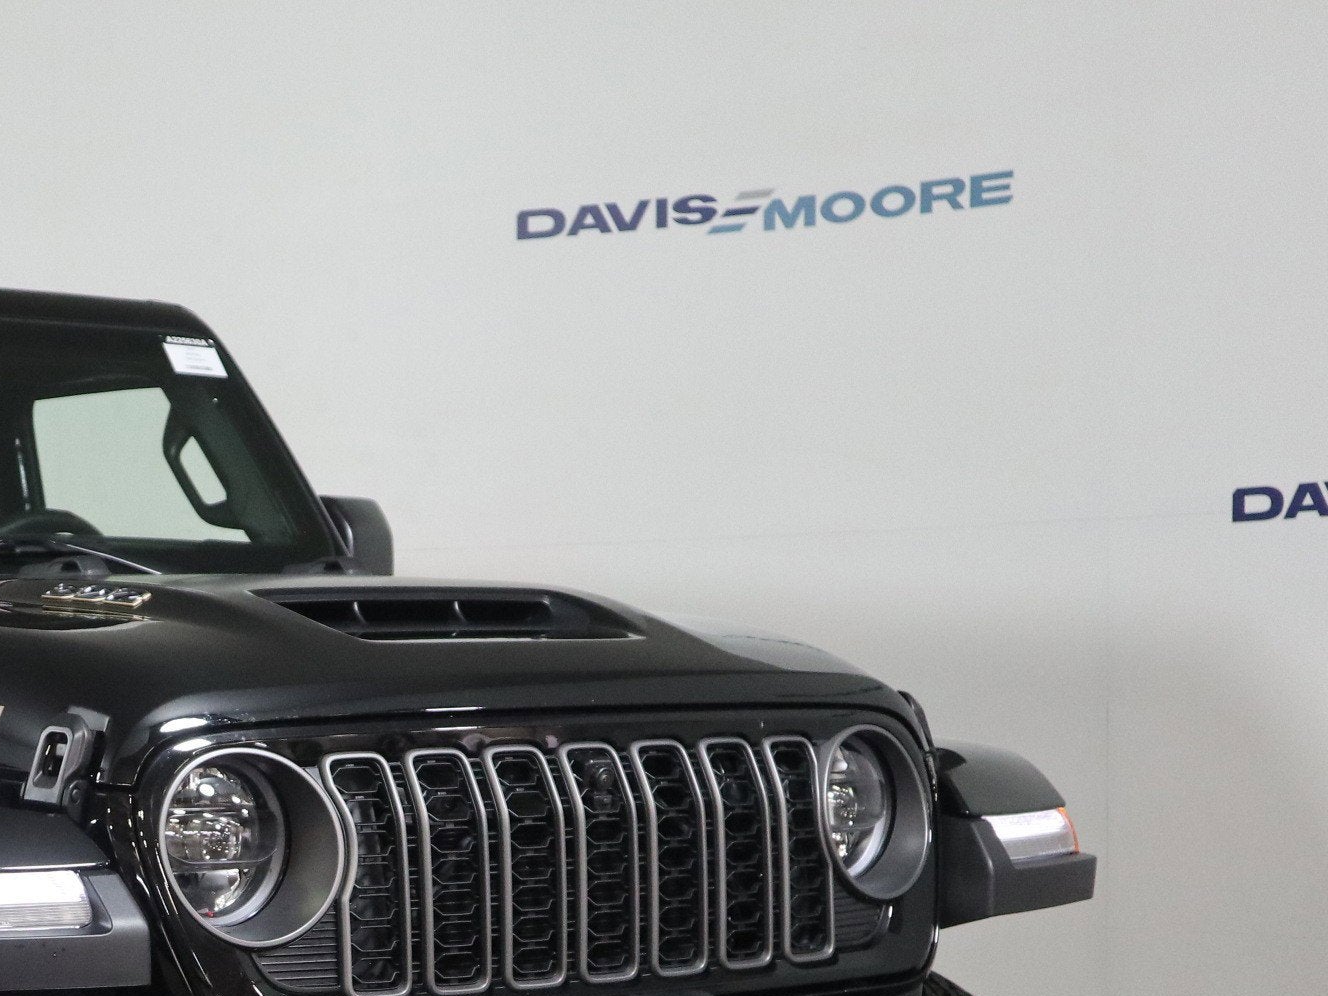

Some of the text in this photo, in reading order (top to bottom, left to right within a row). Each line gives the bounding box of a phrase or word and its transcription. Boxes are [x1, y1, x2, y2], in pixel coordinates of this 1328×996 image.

[517, 170, 1014, 240] DAVIS MOORE
[1232, 482, 1328, 522] DA
